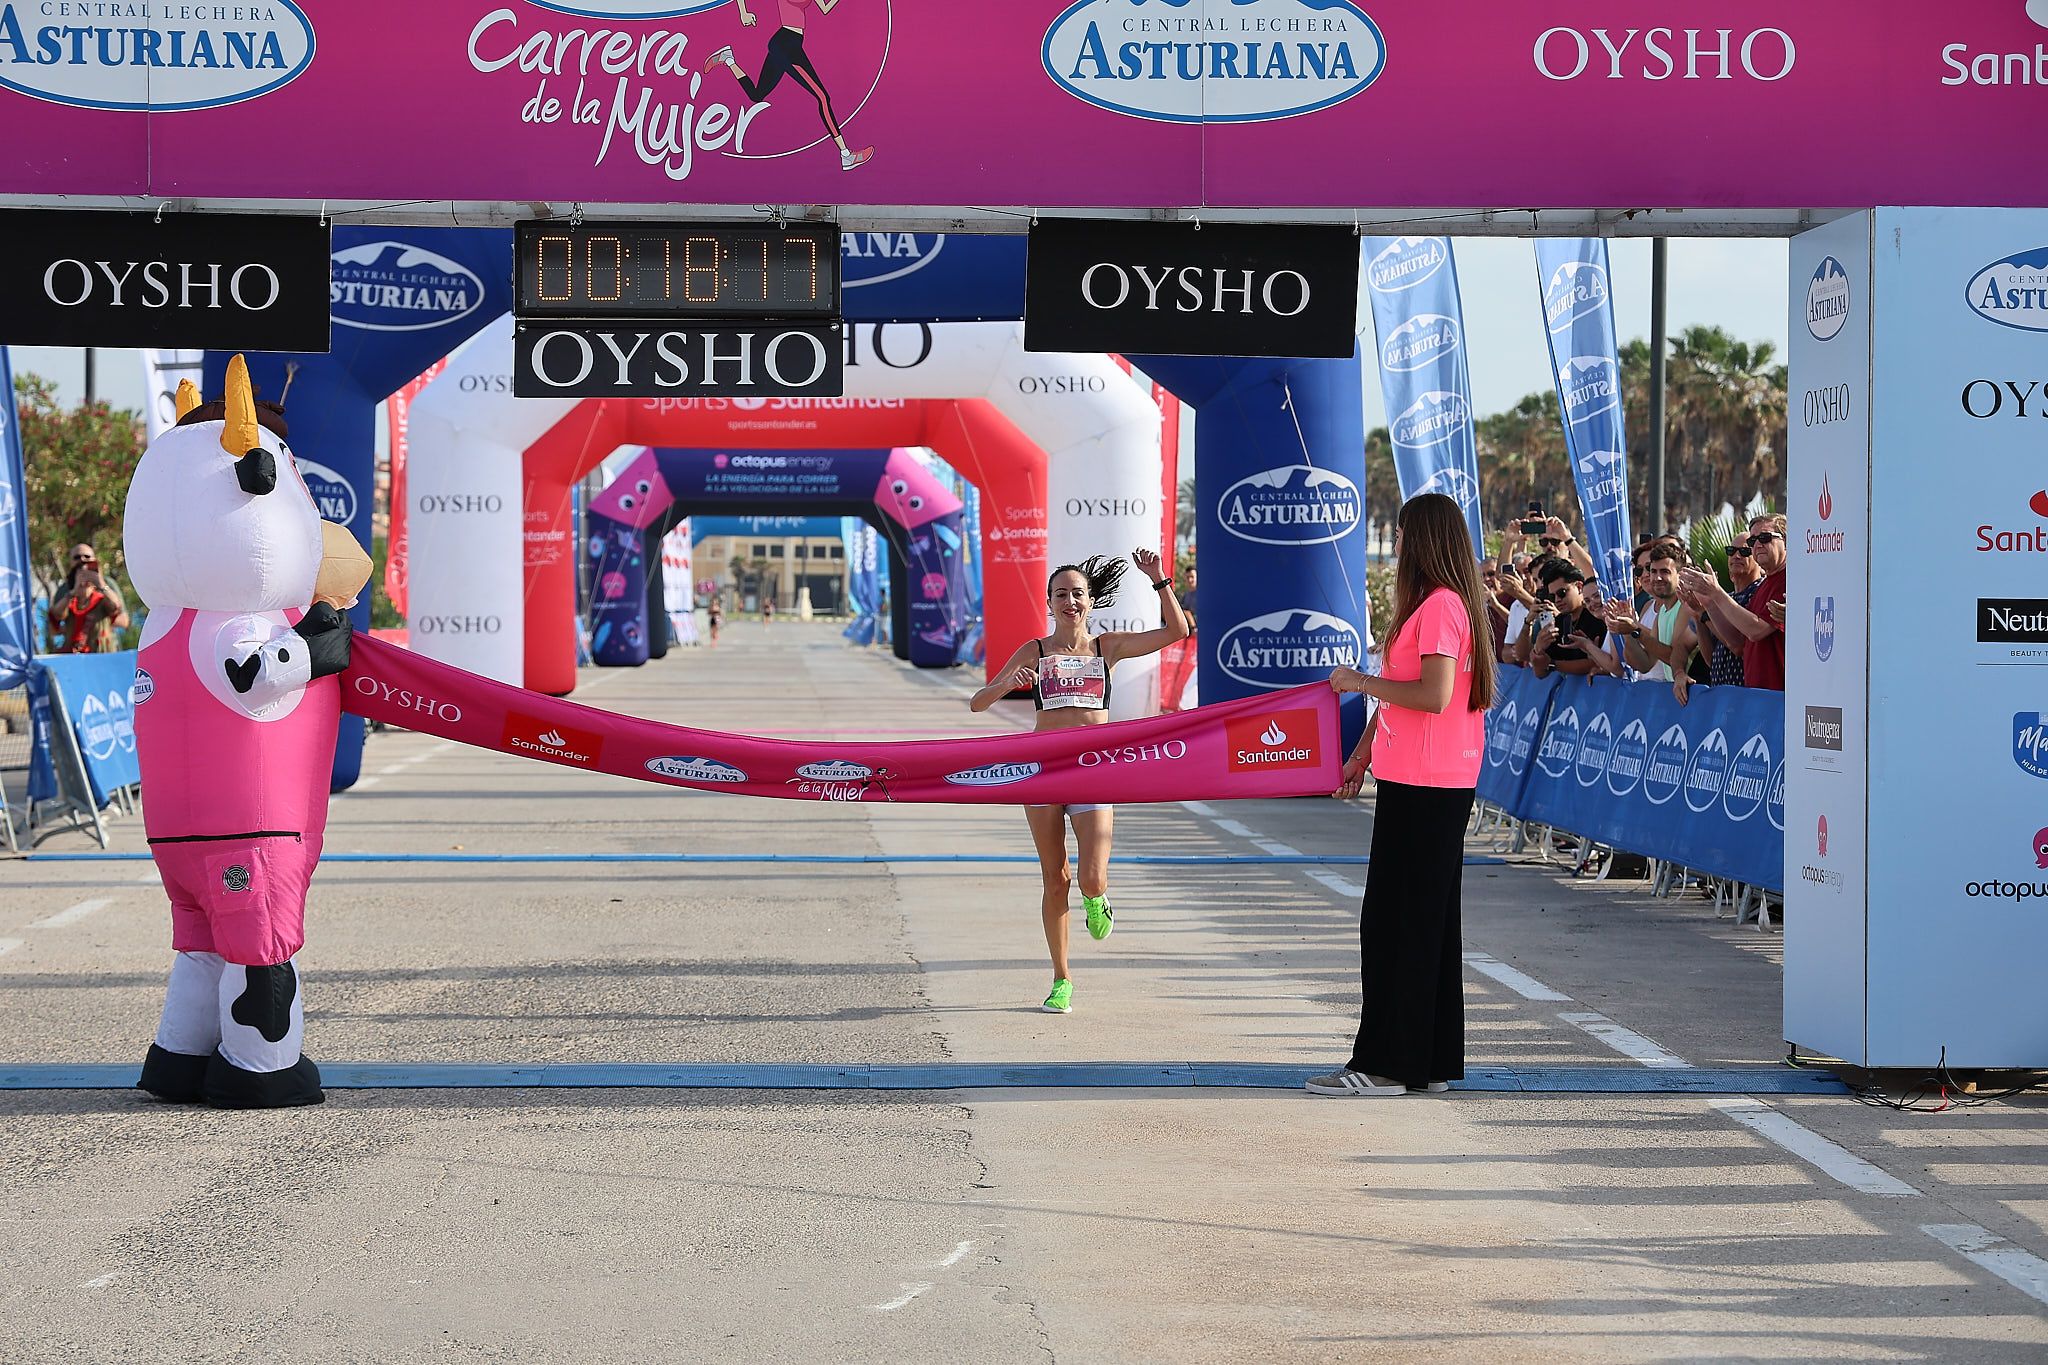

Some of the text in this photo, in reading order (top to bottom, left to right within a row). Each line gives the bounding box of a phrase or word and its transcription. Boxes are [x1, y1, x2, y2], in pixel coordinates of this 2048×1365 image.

[41, 1, 276, 21] CENTRAL LECHERA
[0, 3, 288, 70] ASTURIANA
[1122, 17, 1348, 33] CENTRAL LECHERA
[467, 9, 689, 77] Carrera
[1068, 20, 1360, 81] ASTURIANA
[1533, 26, 1797, 81] OYSHO
[521, 71, 771, 181] de la Mujer
[43, 258, 280, 311] OYSHO
[332, 269, 466, 287] CENTRAL LECHERA
[1081, 262, 1311, 317] OYSHO
[2009, 275, 2048, 284] CENT
[331, 281, 468, 311] STURIANA
[1808, 291, 1847, 323] ASTURIANA
[530, 330, 827, 388] OYSHO
[460, 375, 514, 392] OYS
[1019, 376, 1105, 394] OYSHO
[1804, 383, 1850, 428] OYSHO
[420, 495, 503, 514] OYSHO
[1065, 499, 1147, 517] OYSHO
[1250, 492, 1305, 501] CENTRAL
[1005, 506, 1045, 521] Sports
[1227, 495, 1355, 525] ASTURIANA
[1806, 528, 1845, 554] Santander
[419, 615, 503, 634] OYSHO
[1226, 638, 1354, 668] ASTURIANA
[1250, 636, 1303, 645] CENTRAL
[1060, 677, 1085, 687] 016
[354, 675, 463, 724] OYSHO
[1807, 714, 1841, 745] Neutrogena
[510, 736, 590, 763] Santander
[1077, 739, 1187, 768] OYSHO
[1236, 746, 1312, 765] Santander
[653, 760, 739, 782] ASTURIANA
[801, 766, 867, 777] ASTURIANA
[798, 781, 869, 801] de la Mujer
